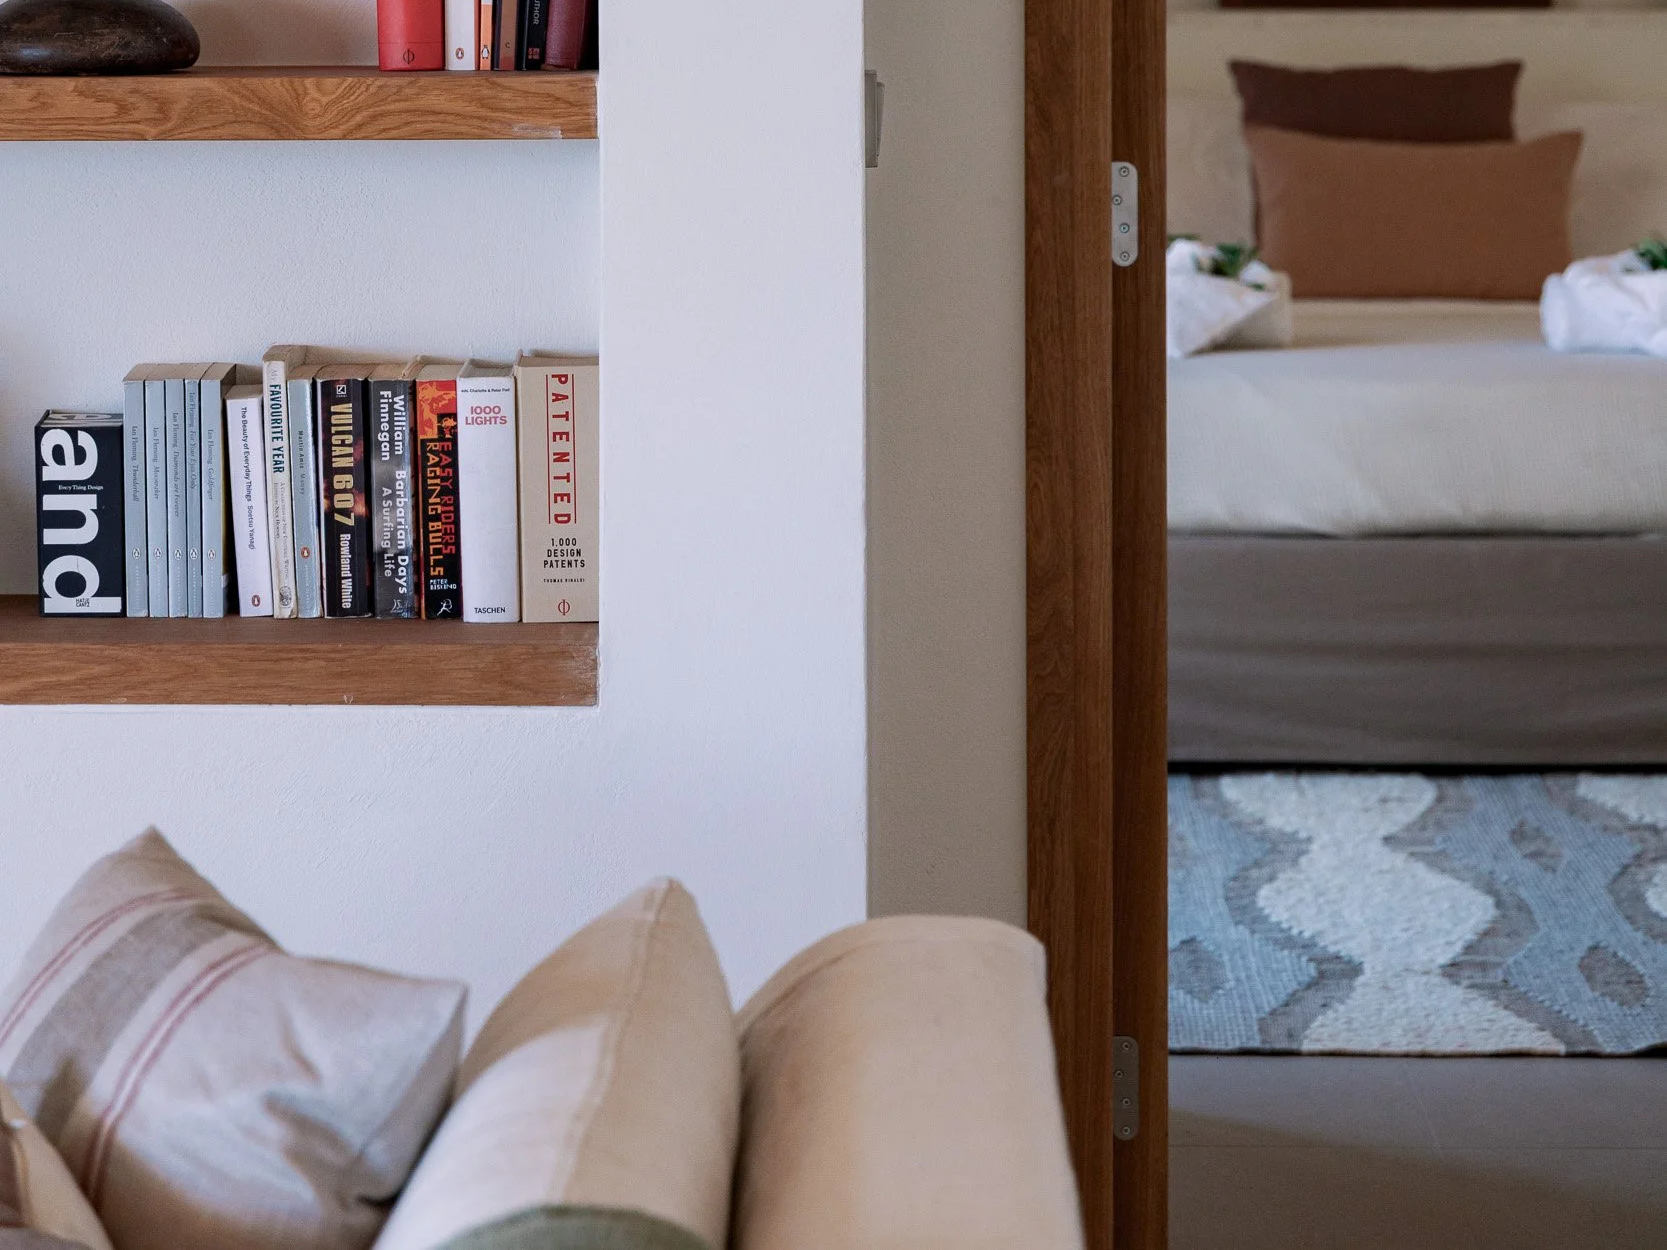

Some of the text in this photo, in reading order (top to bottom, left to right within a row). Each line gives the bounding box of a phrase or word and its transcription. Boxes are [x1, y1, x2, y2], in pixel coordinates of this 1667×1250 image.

[270, 384, 284, 443] FAVOURITE
[331, 403, 354, 468] VULCAN
[378, 391, 392, 461] Finnegan
[394, 395, 406, 455] William
[465, 416, 508, 426] LIGHTS
[470, 406, 501, 415] 1000
[272, 446, 285, 474] YEAR
[551, 374, 571, 524] PATENTED
[132, 465, 140, 502] Thunderball
[243, 451, 251, 481] Everyday
[248, 528, 256, 550] Yanagi
[333, 474, 355, 526] 607
[396, 471, 409, 549] Barbarian
[426, 443, 444, 576] RAGING BULLS
[440, 442, 456, 554] EASY RIDERS
[40, 428, 122, 614] and
[381, 487, 395, 577] A Surfing Life
[551, 538, 577, 547] 1,000
[340, 534, 353, 609] Rowland White
[395, 556, 409, 594] Days
[544, 559, 585, 569] PATENTS
[547, 548, 582, 558] DESIGN
